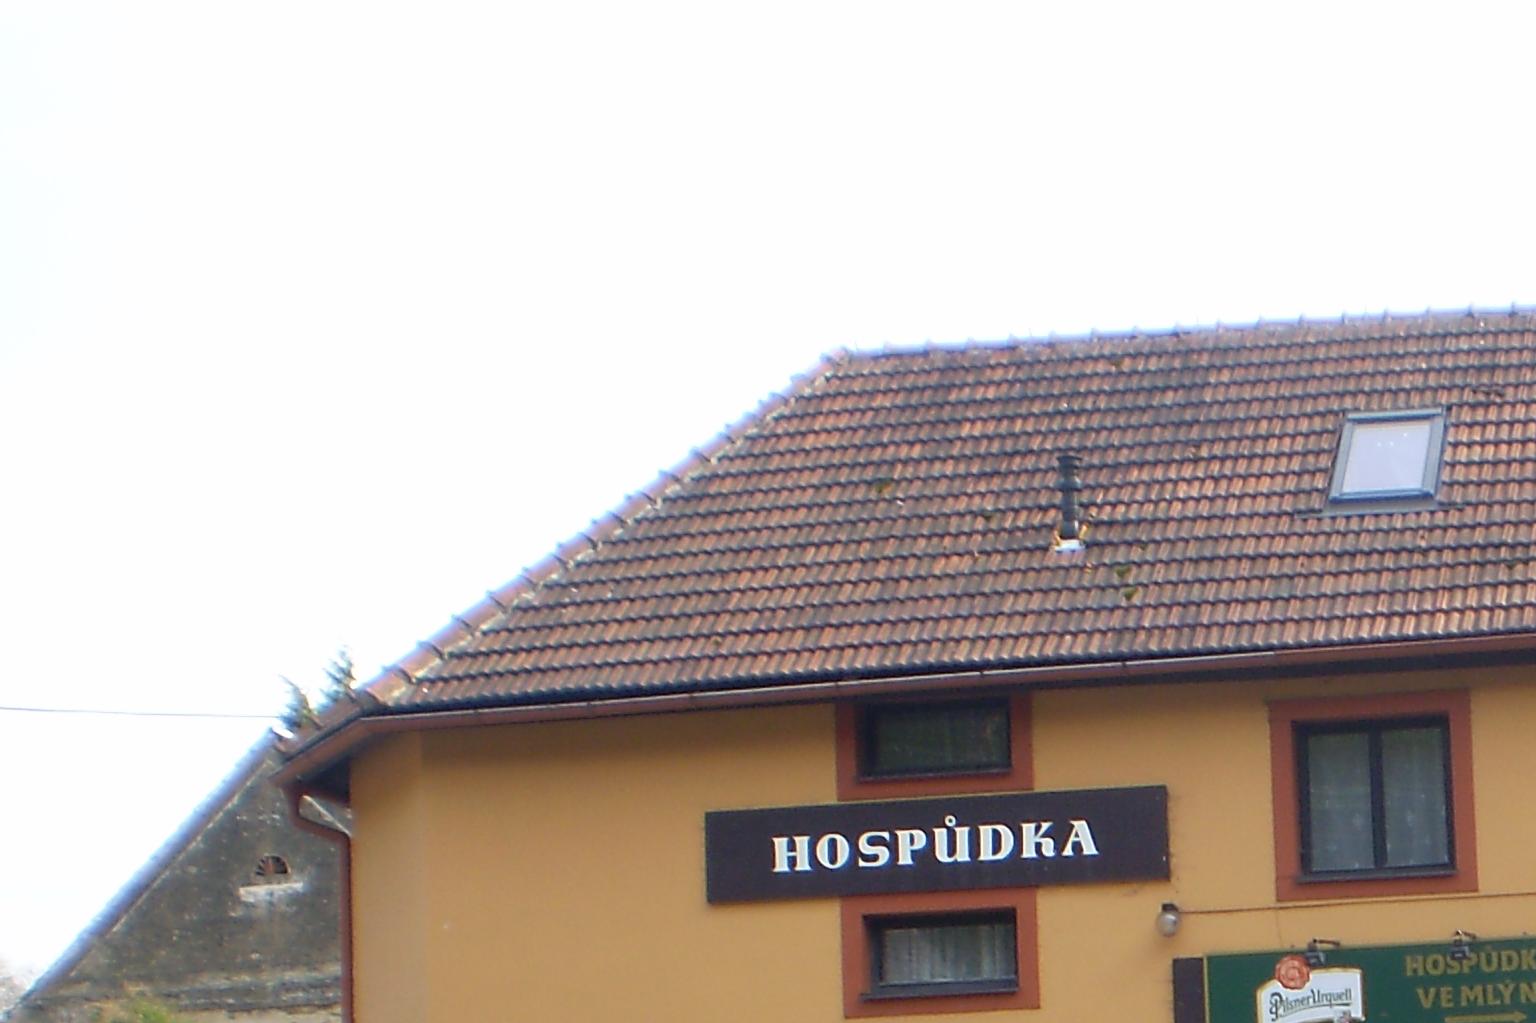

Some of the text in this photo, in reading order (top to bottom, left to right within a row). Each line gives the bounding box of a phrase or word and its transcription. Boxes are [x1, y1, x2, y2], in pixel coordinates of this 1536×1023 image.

[772, 815, 1099, 874] HOSPŮDKA
[1269, 988, 1352, 1021] Pilsner Urquell
[1416, 985, 1454, 1008] VE
